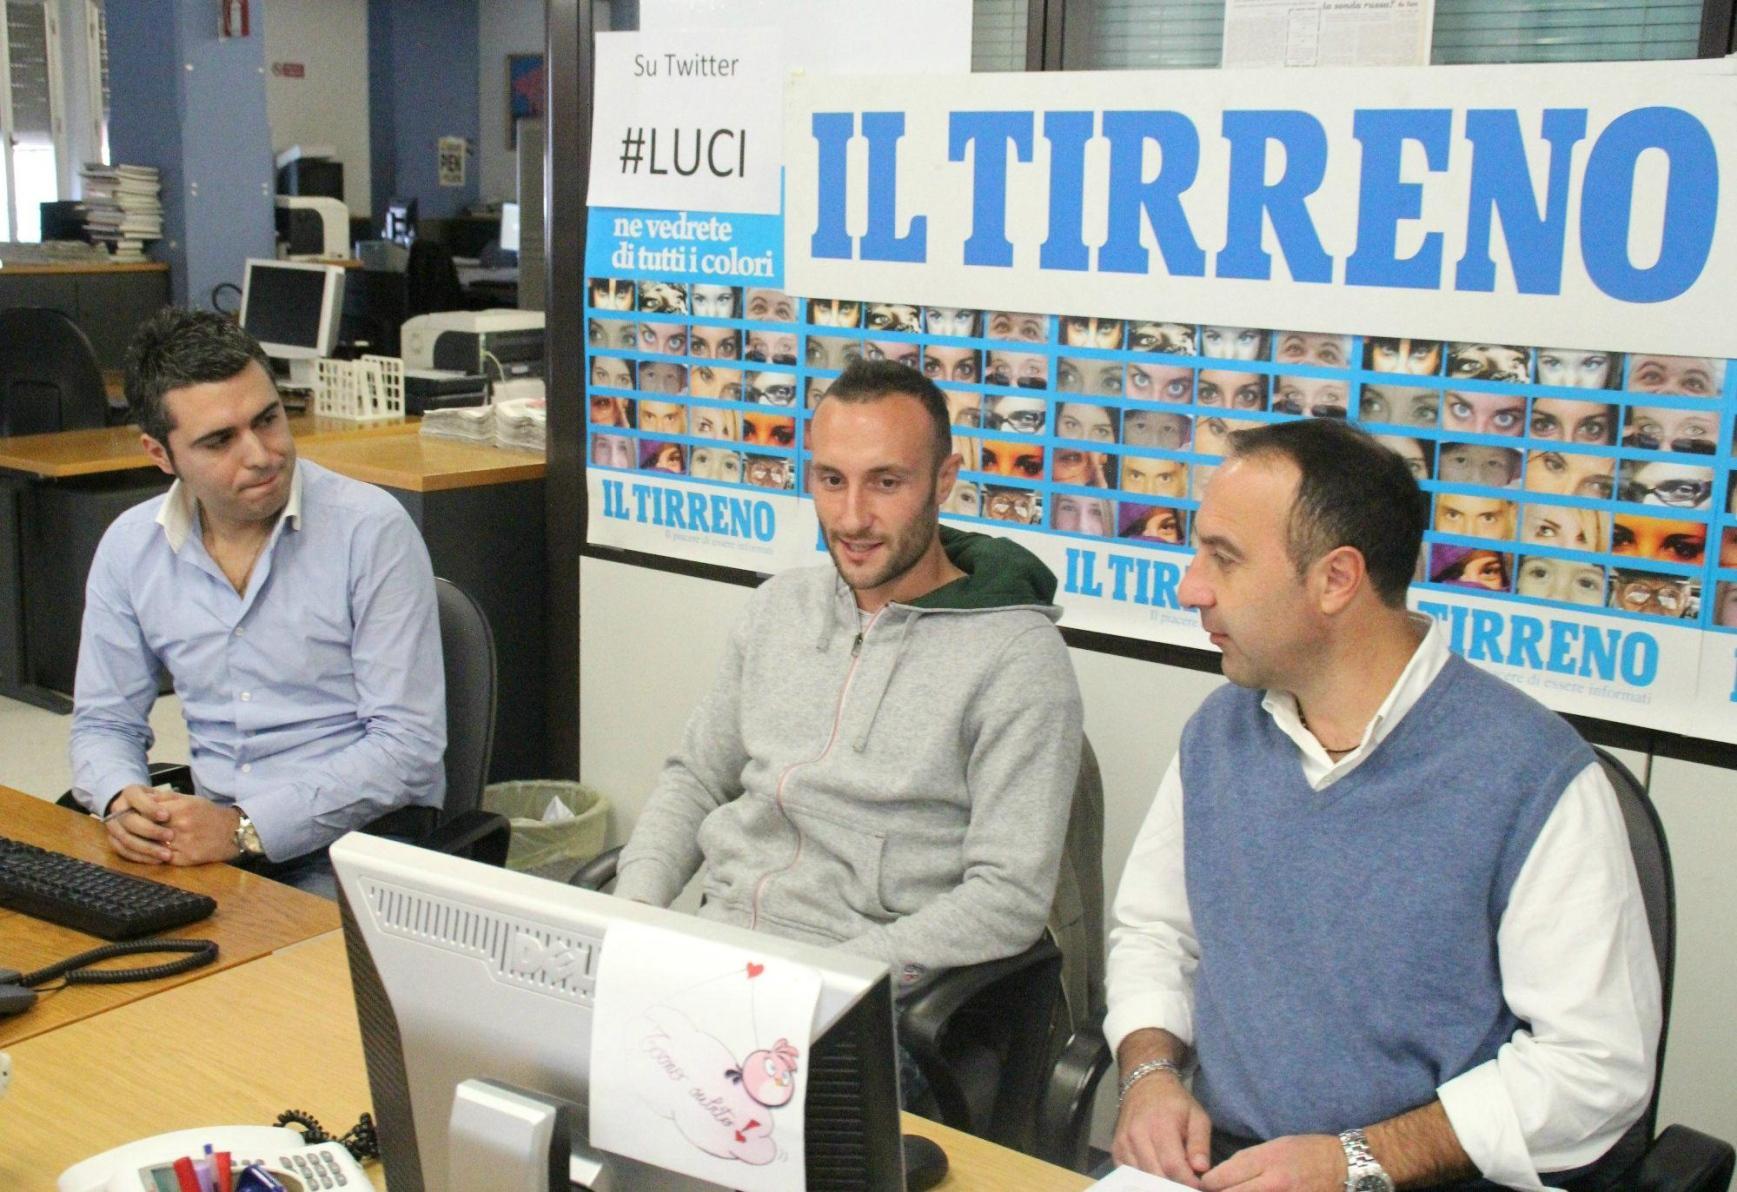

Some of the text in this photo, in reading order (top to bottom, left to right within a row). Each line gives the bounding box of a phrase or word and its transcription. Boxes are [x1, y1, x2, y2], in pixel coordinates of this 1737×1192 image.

[633, 53, 740, 78] Su Twitter
[619, 127, 747, 178] #LUCI
[612, 211, 732, 242] ne vedrete
[811, 106, 1719, 304] IL TIRRENO
[611, 241, 775, 278] di tutti i colori
[602, 478, 630, 521] IL
[631, 483, 776, 543] TIRRENO
[1064, 547, 1198, 613] IL TIR
[1526, 673, 1541, 687] di
[1543, 677, 1586, 695] essere
[1587, 682, 1653, 705] informati
